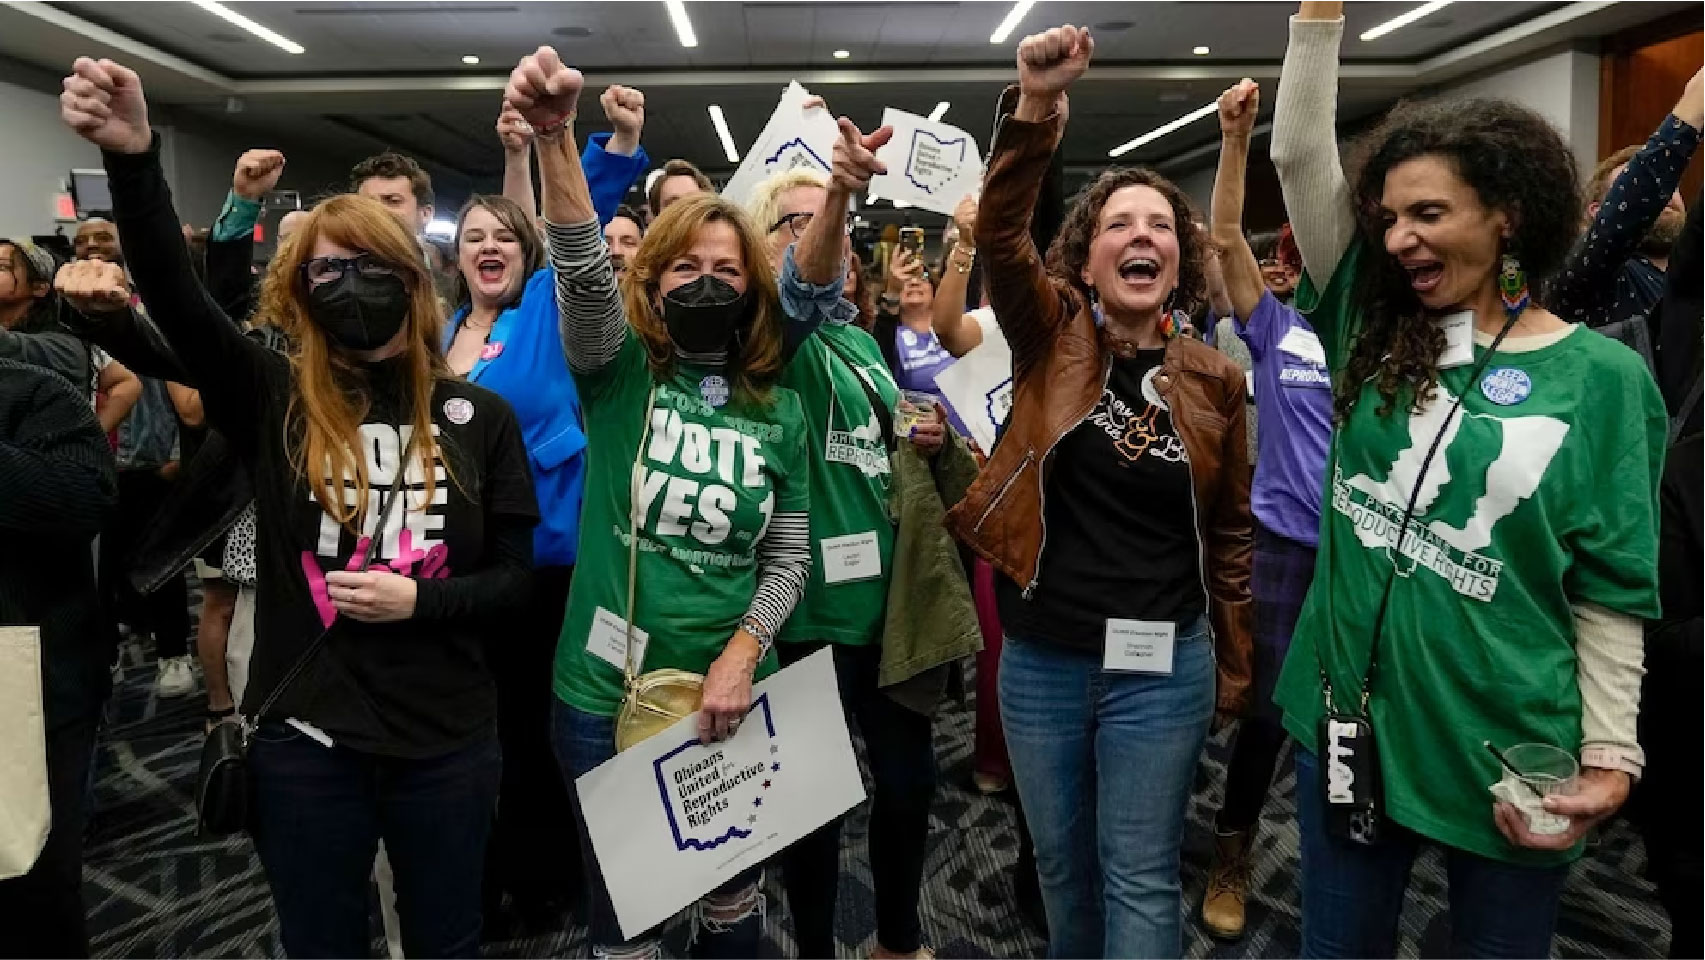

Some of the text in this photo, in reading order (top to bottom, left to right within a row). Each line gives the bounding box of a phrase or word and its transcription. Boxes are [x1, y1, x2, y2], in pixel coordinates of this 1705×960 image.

[648, 408, 766, 487] VOTE
[631, 464, 738, 545] YES
[1462, 551, 1503, 577] FOR
[673, 749, 723, 784] Ohioans
[678, 766, 720, 798] United
[683, 761, 765, 814] Reproductive
[687, 797, 729, 829] Rights
